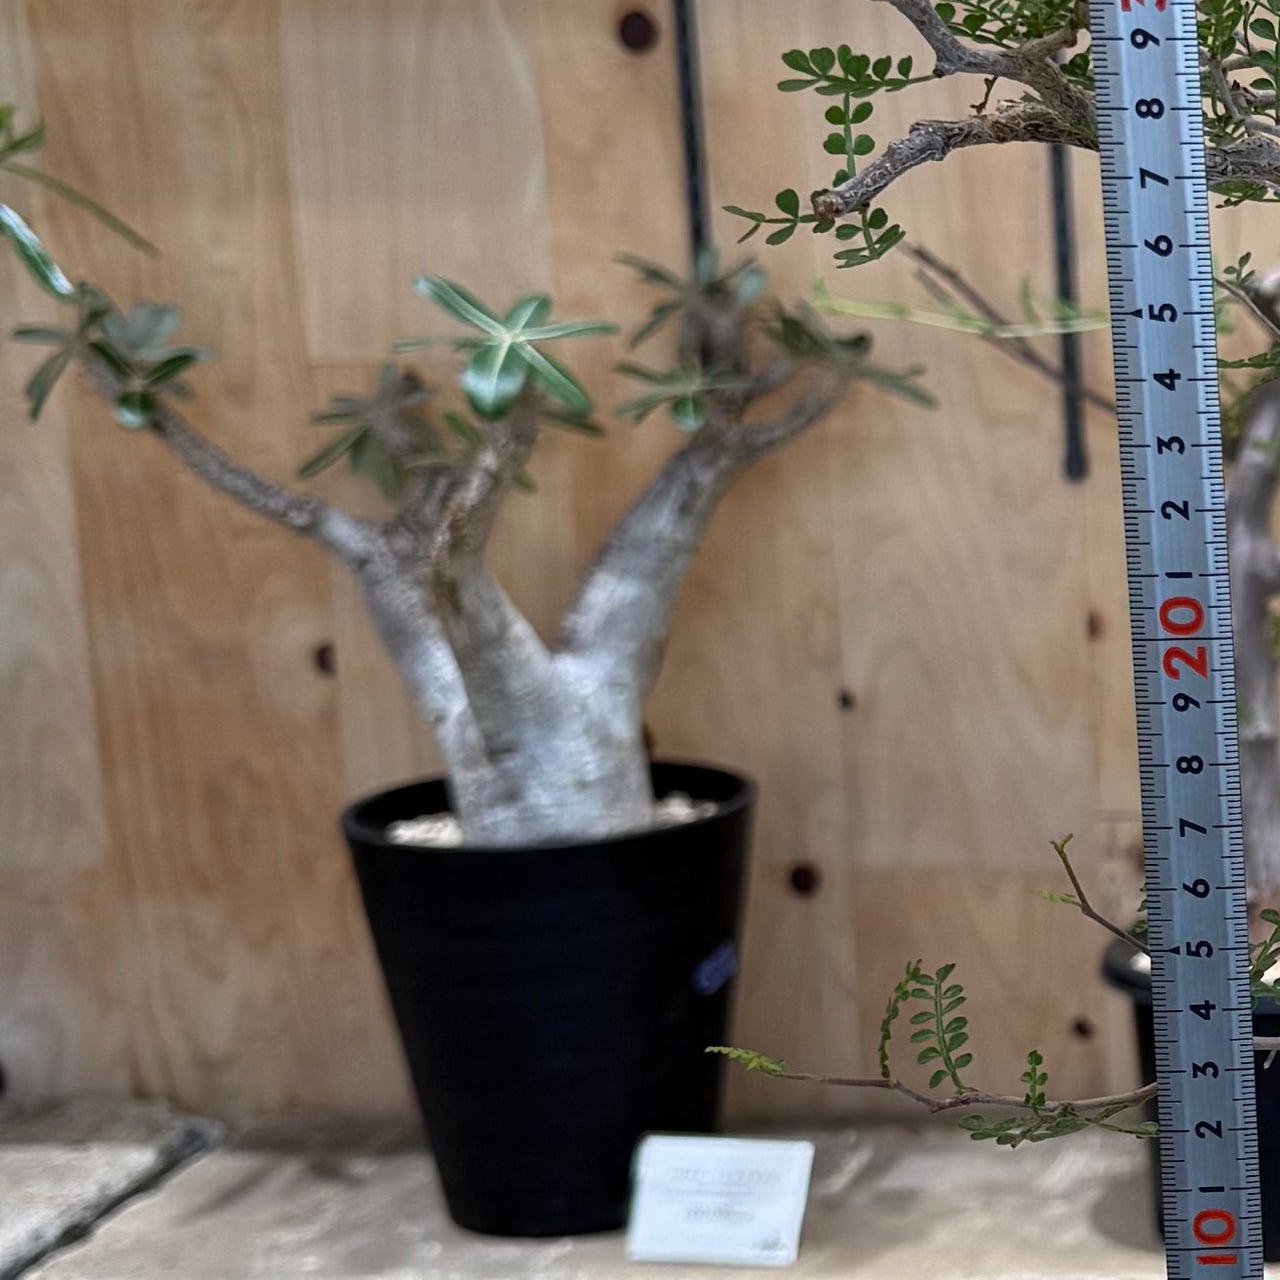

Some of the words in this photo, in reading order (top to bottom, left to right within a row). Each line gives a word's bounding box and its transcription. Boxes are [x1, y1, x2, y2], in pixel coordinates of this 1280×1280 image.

[1131, 29, 1160, 49] 9
[1135, 98, 1165, 120] 8
[1140, 168, 1169, 188] 7
[1144, 235, 1174, 257] 6
[1149, 303, 1178, 323] 5
[1153, 368, 1182, 391] 4
[1157, 435, 1186, 455] 3
[1161, 500, 1190, 520] 2
[1159, 597, 1207, 679] 20
[1172, 693, 1201, 712] 9
[1176, 754, 1204, 775] 8
[1179, 818, 1207, 837] 7
[1183, 878, 1211, 899] 6
[1186, 940, 1214, 959] 5
[1189, 1000, 1216, 1021] 4
[1192, 1061, 1220, 1079] 3
[1195, 1120, 1223, 1140] 2
[1192, 1209, 1237, 1265] 10
